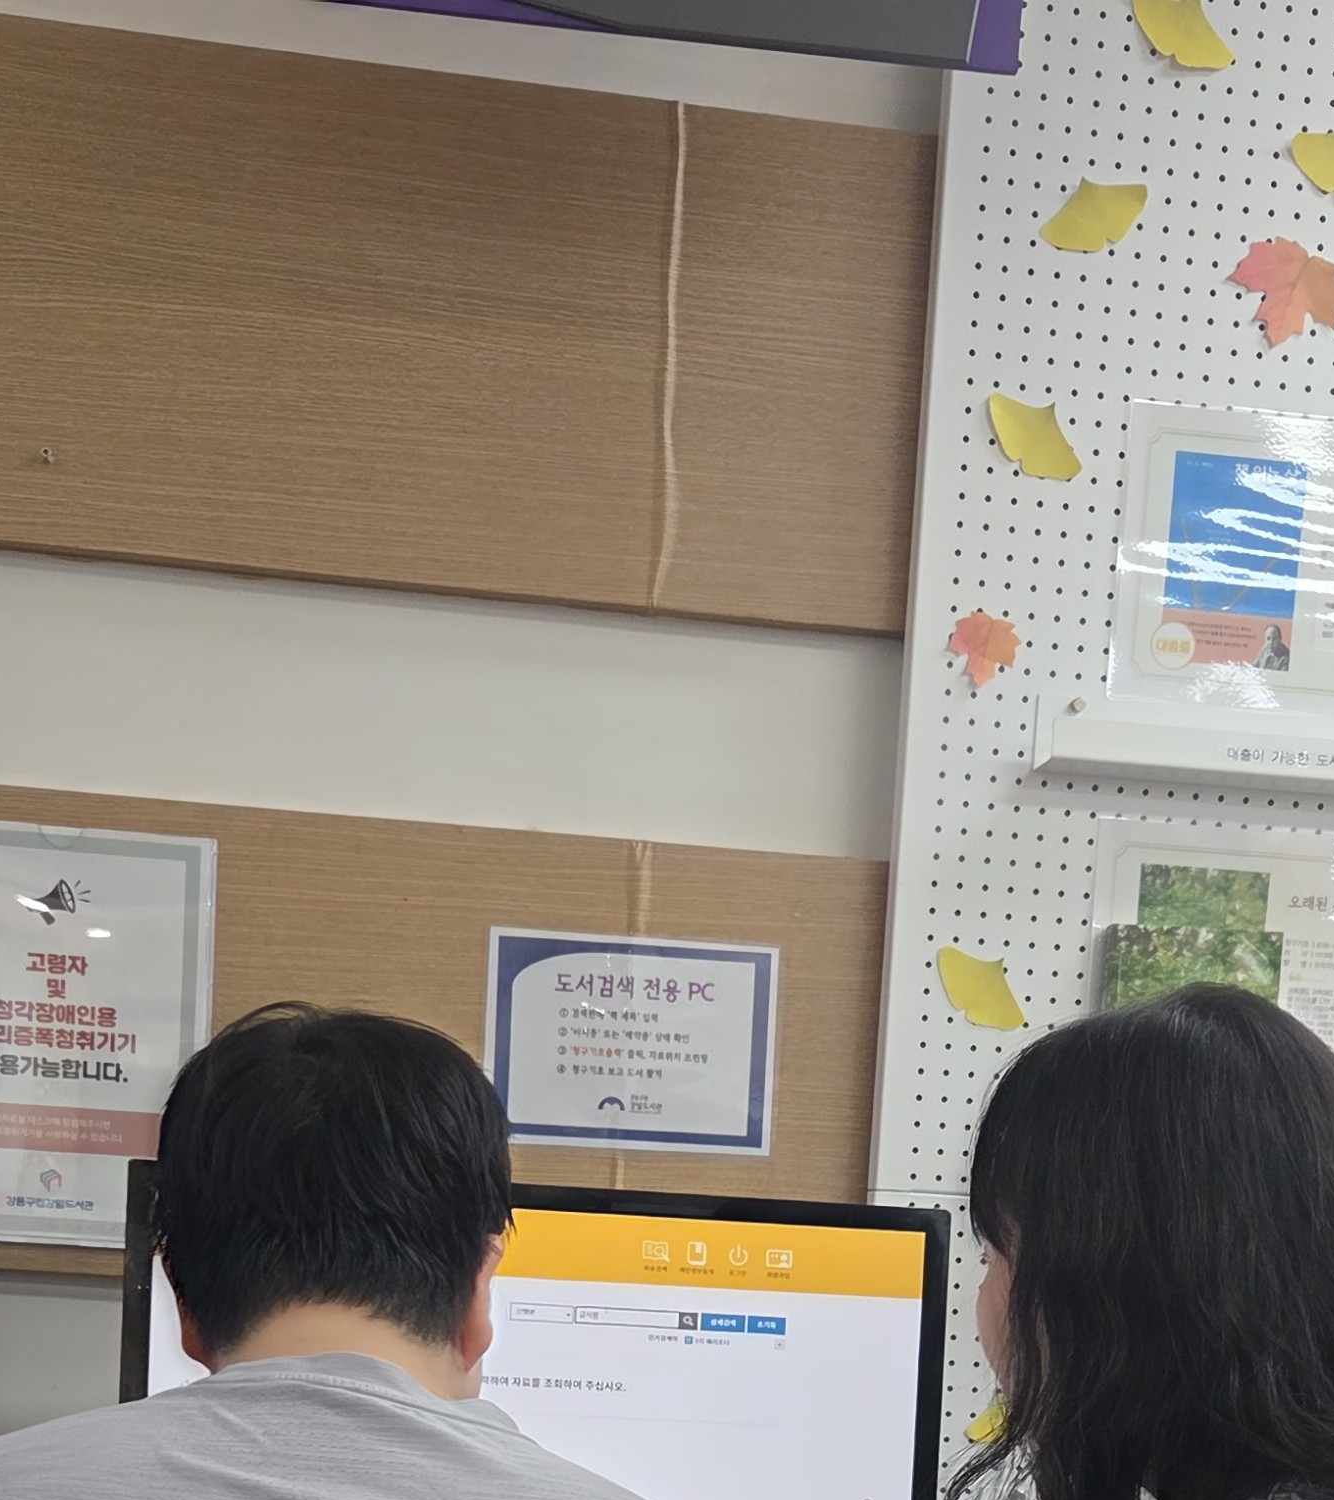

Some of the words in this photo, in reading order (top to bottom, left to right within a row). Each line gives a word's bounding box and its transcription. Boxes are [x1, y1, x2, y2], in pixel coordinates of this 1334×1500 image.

[1227, 747, 1265, 765] 대출이
[1271, 749, 1310, 768] 가능한
[1288, 895, 1328, 913] 오래된
[26, 952, 88, 976] 고령자
[46, 978, 66, 999] 및
[554, 973, 635, 999] 도서검색
[643, 978, 681, 1003] 전용
[688, 982, 715, 1002] PC
[512, 1377, 540, 1388] 자료를
[544, 1379, 582, 1390] 조회하여
[586, 1381, 626, 1392] 주십시오.
